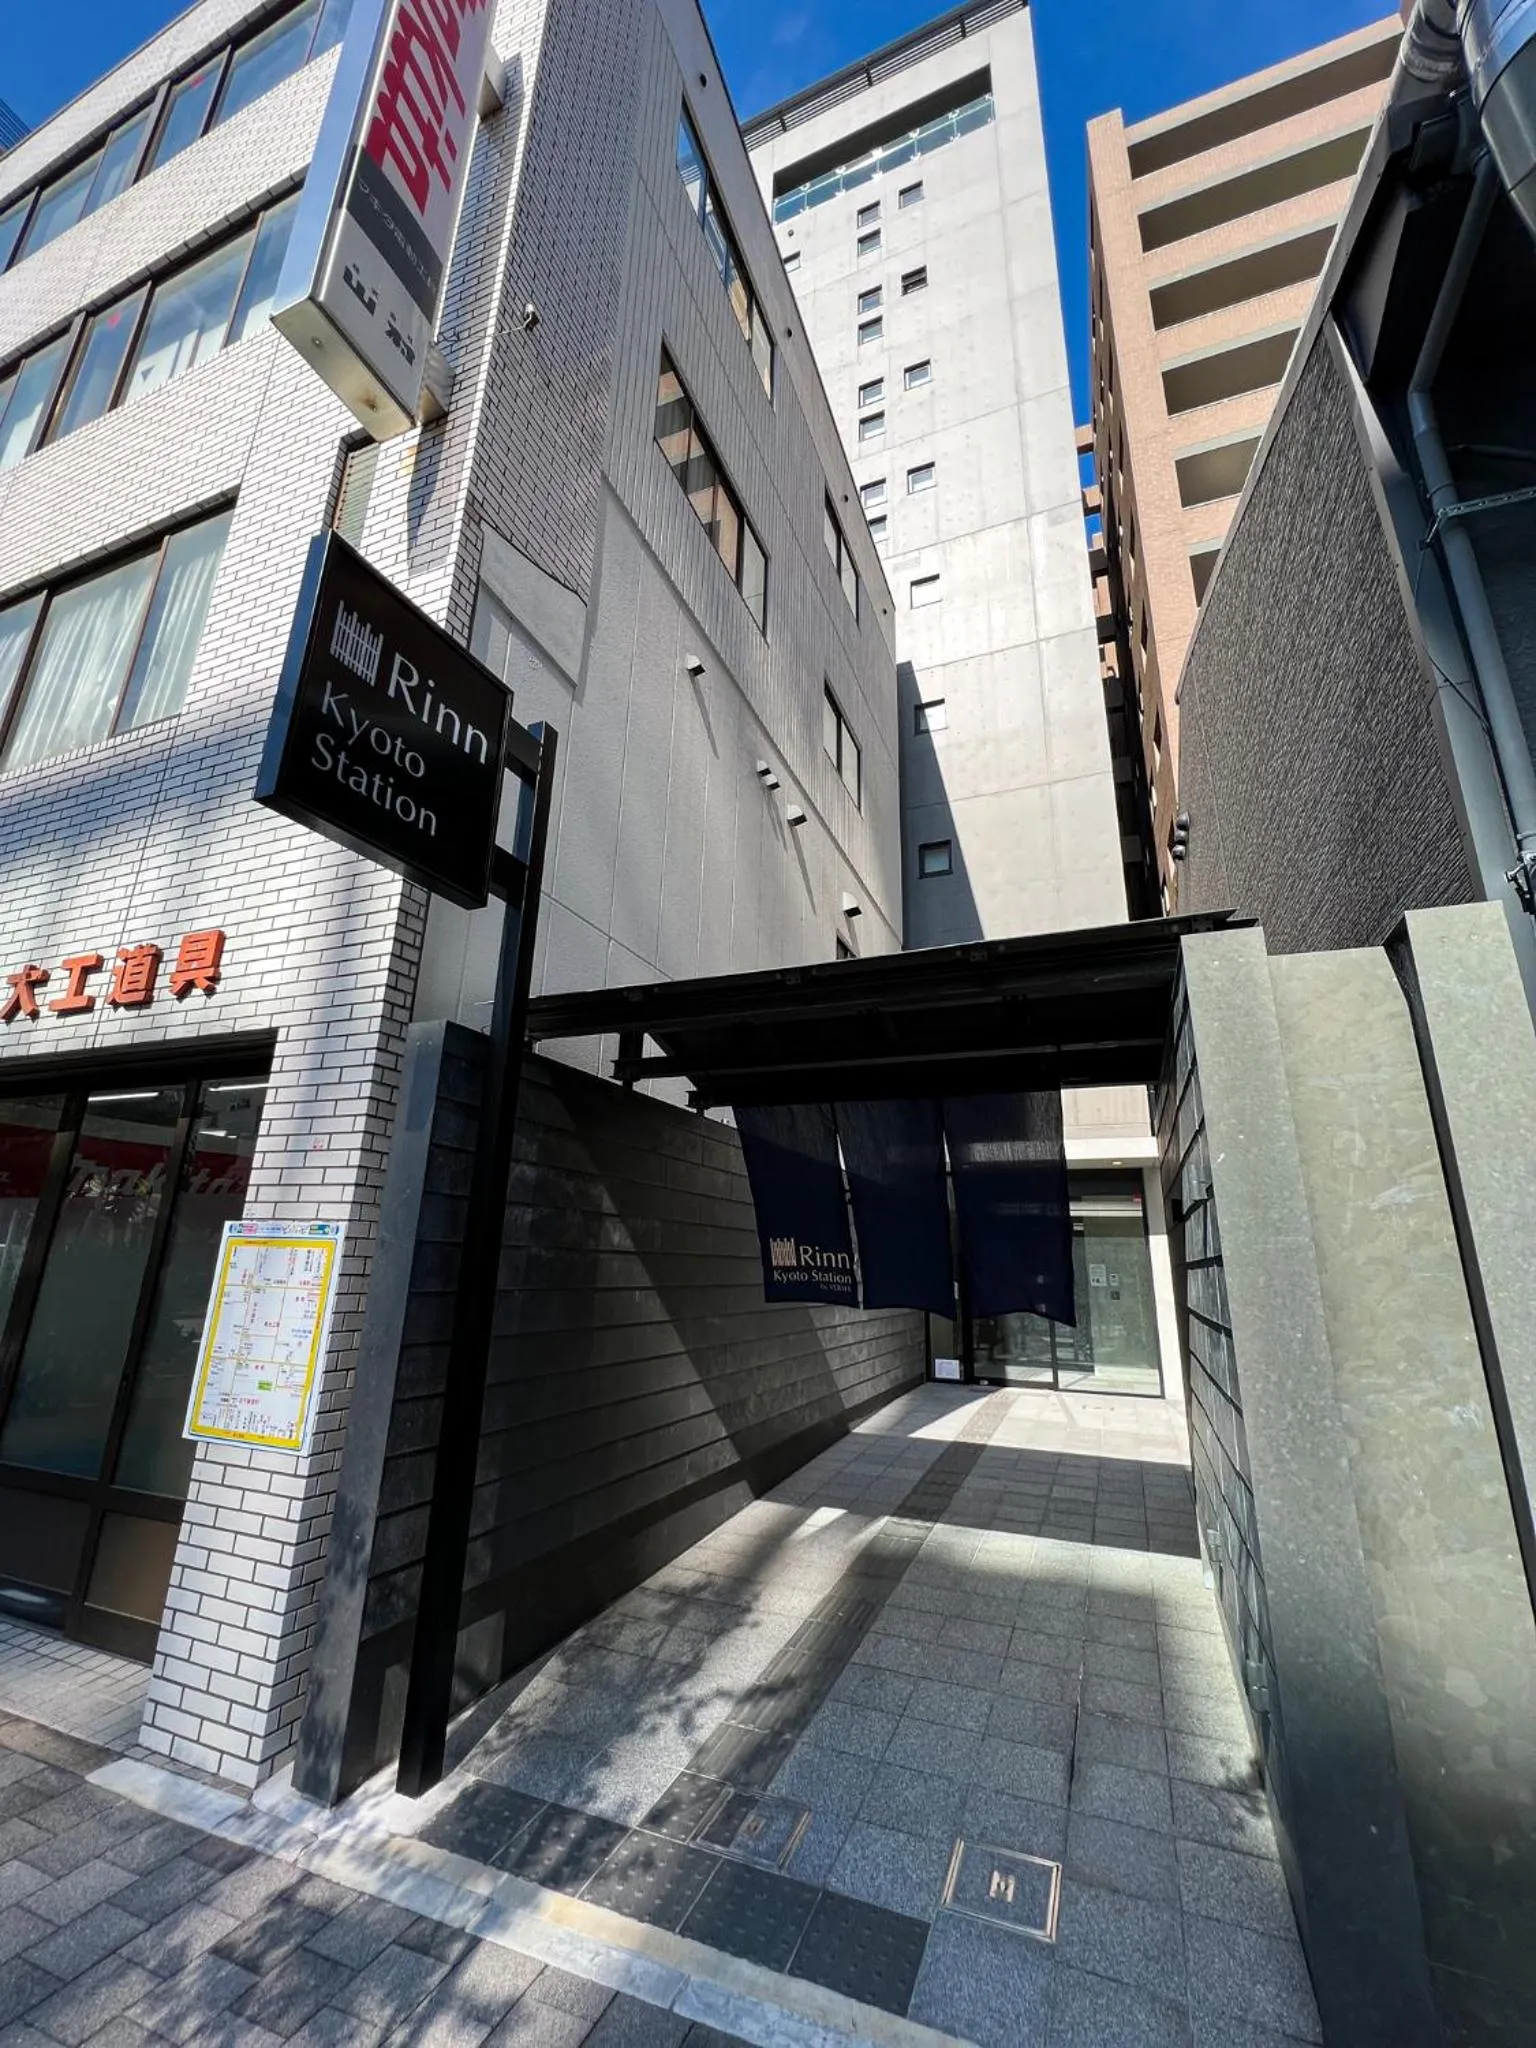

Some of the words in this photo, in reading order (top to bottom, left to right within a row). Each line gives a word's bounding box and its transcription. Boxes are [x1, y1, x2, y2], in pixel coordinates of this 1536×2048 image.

[364, 0, 487, 217] akita
[320, 681, 427, 779] Kyoto
[387, 651, 489, 765] Rinn
[311, 732, 437, 836] Station
[0, 930, 225, 1023] 大工道具
[773, 1269, 808, 1284] Kyoto
[811, 1270, 852, 1285] Station
[799, 1245, 850, 1269] Rinn
